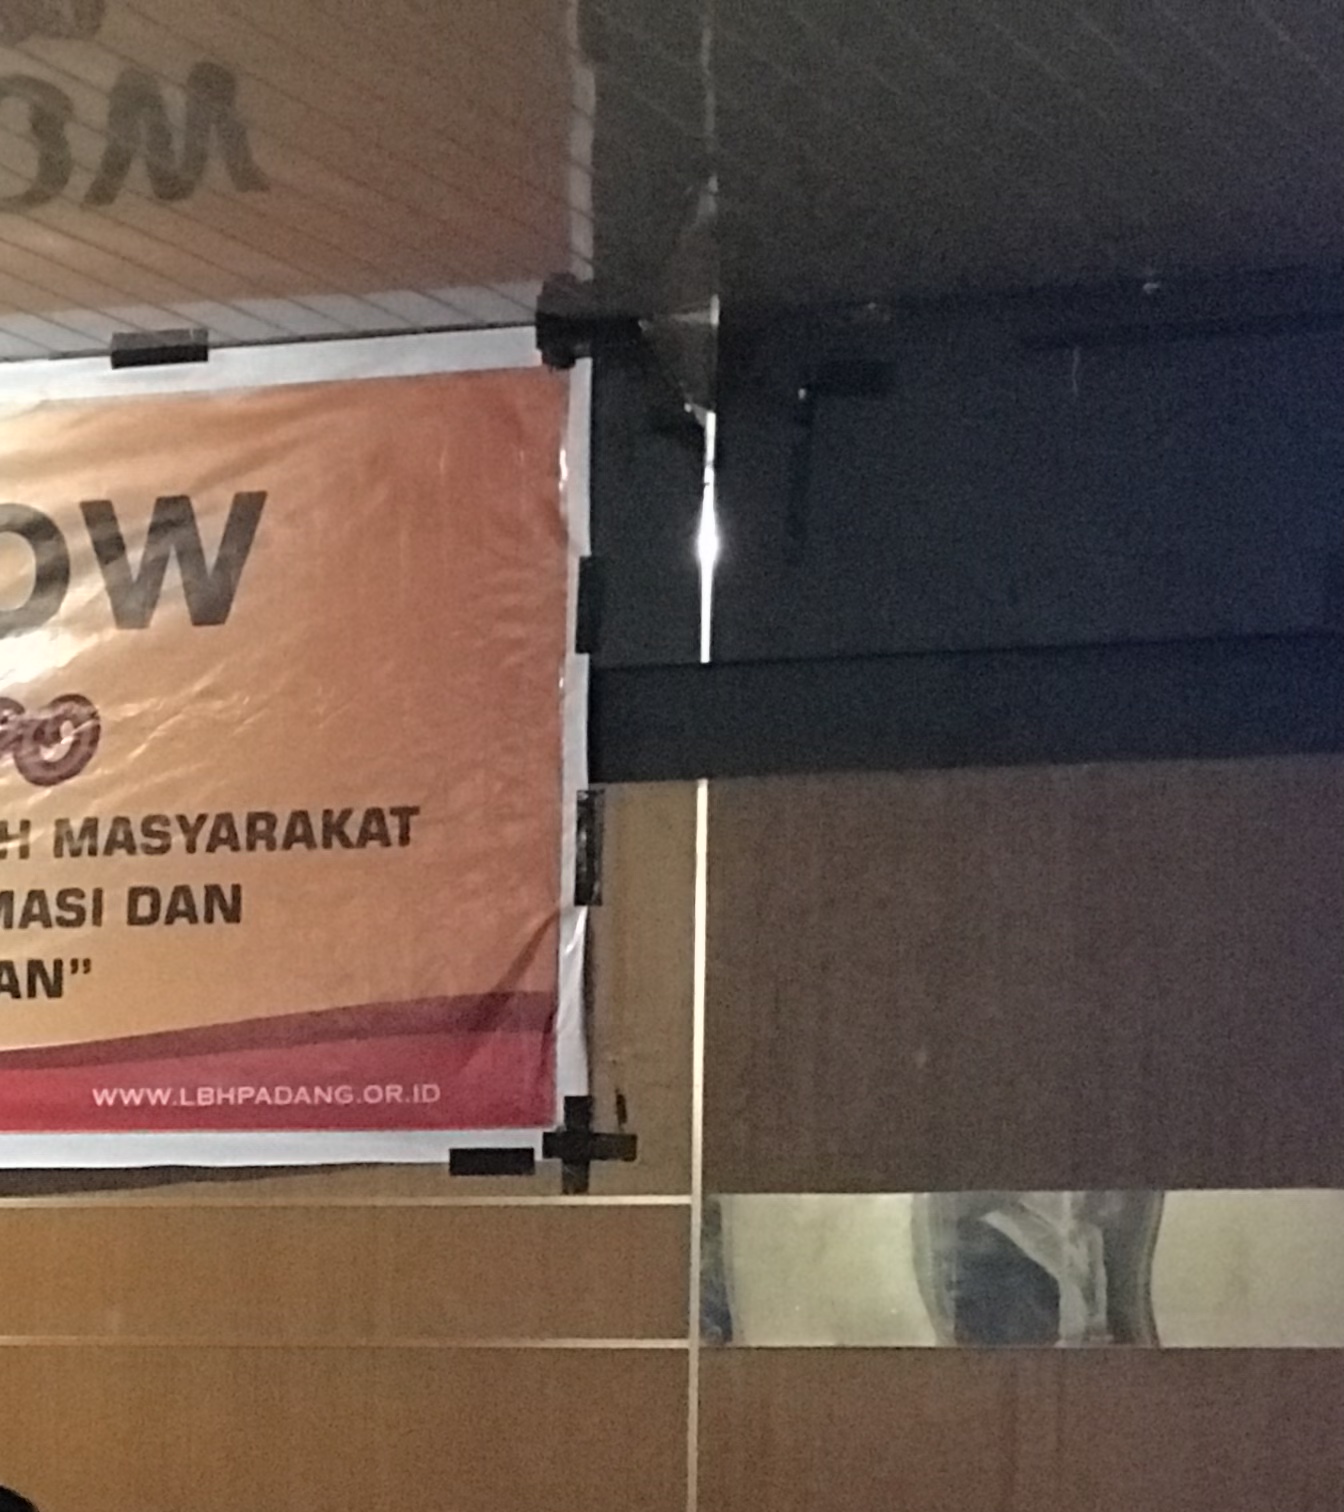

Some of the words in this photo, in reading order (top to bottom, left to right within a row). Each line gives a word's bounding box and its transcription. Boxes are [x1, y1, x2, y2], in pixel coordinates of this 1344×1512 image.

[53, 806, 420, 859] MASYARAKAT
[127, 884, 243, 927] DAN
[92, 1083, 442, 1107] WWW.LBHPADANG.OR.ID
